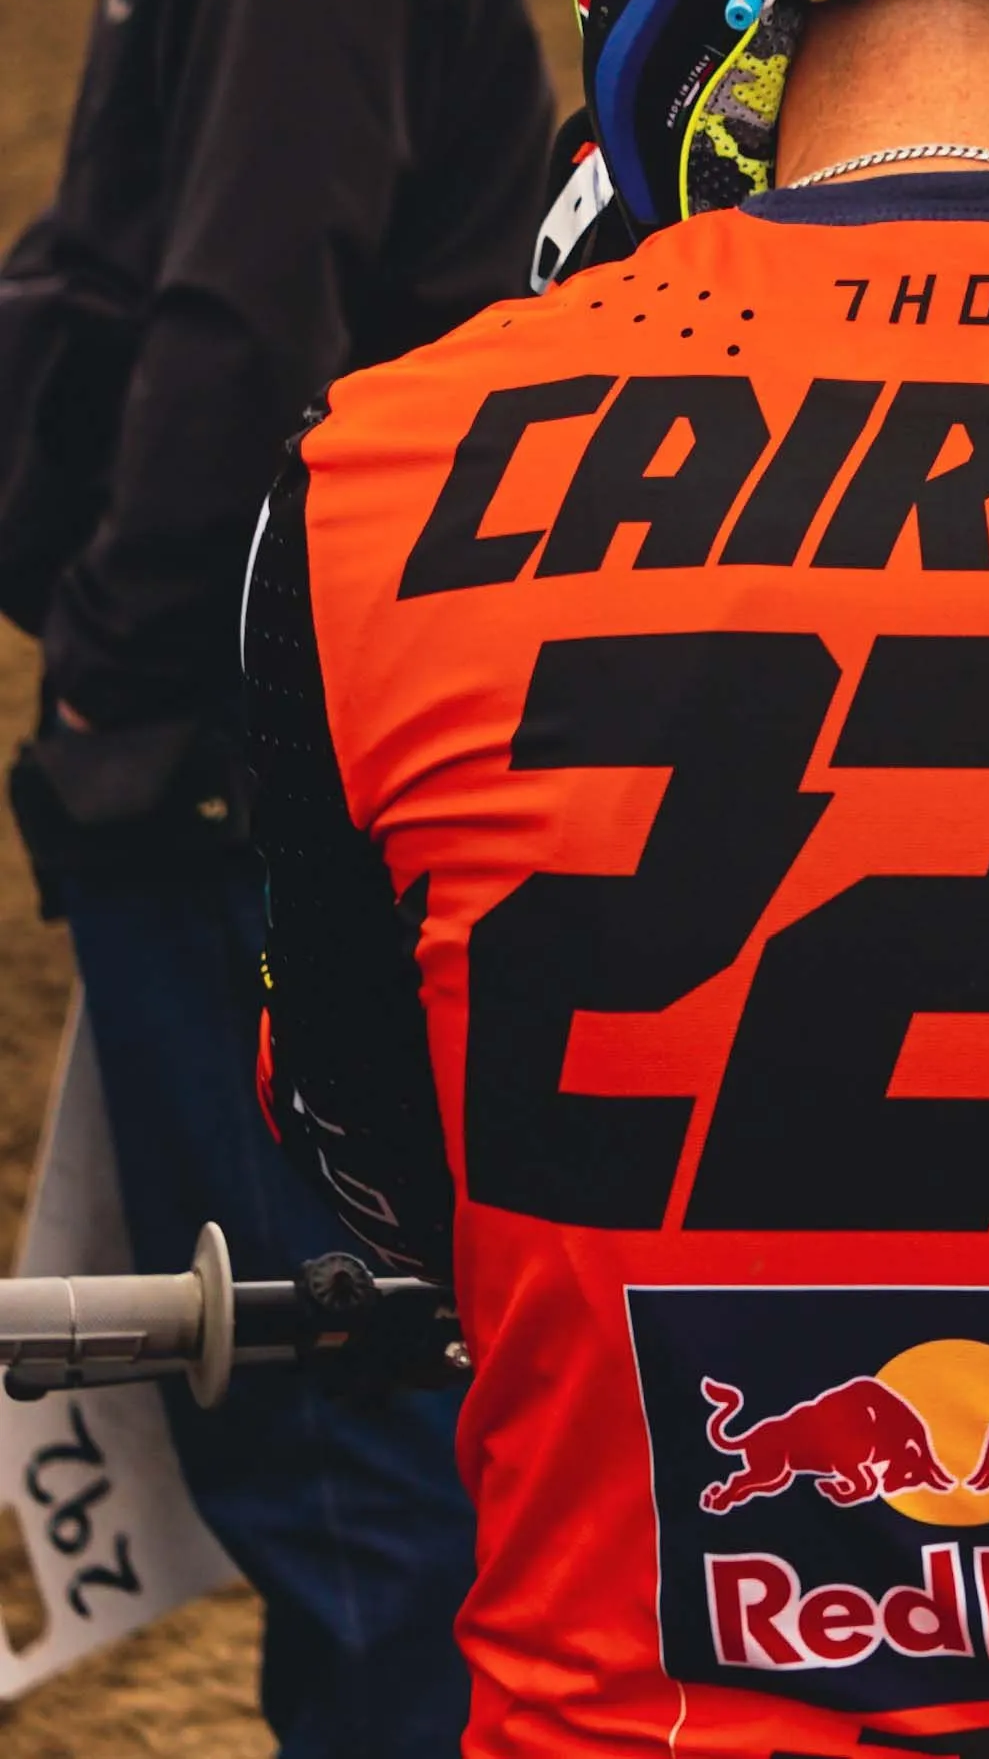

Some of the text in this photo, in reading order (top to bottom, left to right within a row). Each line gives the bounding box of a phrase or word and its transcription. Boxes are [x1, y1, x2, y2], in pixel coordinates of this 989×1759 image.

[666, 54, 711, 130] MADE IN ITALY
[26, 1396, 142, 1620] 292
[703, 1542, 975, 1670] Red
